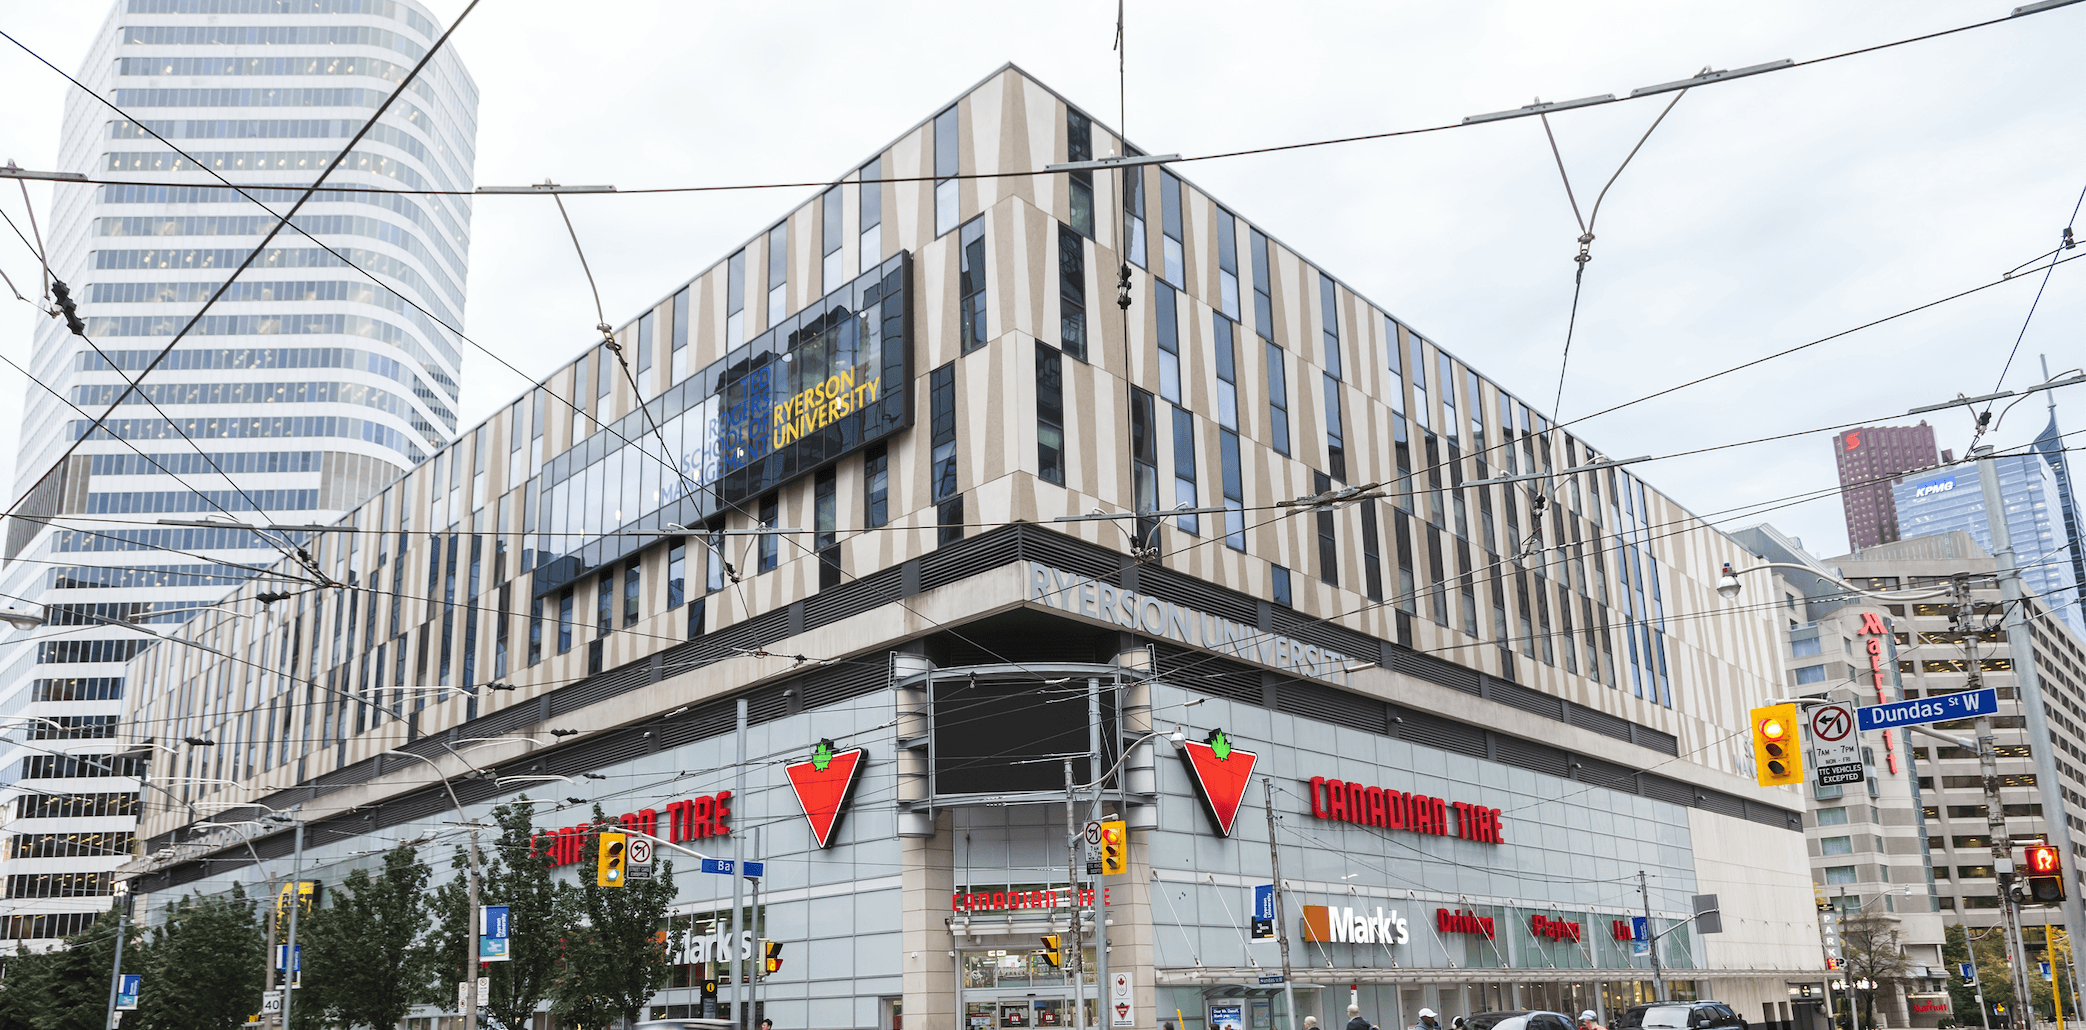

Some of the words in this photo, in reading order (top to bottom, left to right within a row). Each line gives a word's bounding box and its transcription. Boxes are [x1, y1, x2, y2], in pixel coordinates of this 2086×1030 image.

[740, 366, 771, 398] TED
[773, 365, 856, 428] RYERSON
[709, 388, 770, 439] ROGERS
[773, 376, 880, 449] UNIVERSITY
[682, 425, 746, 474] SCHOOL
[749, 411, 770, 439] OF
[661, 433, 770, 506] MANAGEMENT
[1916, 481, 1954, 498] KPMG
[1030, 560, 1193, 644] RYERSON
[1199, 610, 1356, 688] UNIVERSITY
[1871, 702, 1944, 724] Dundas
[1948, 697, 1959, 707] St
[1962, 693, 1980, 711] W
[1816, 748, 1830, 756] 7AM
[1840, 746, 1854, 754] 7PM
[1818, 768, 1830, 776] TTC
[1832, 764, 1862, 774] VEHICLES
[1824, 773, 1859, 784] EXCEPTED
[666, 790, 732, 844] TIRE
[1310, 775, 1448, 836] CANADIAN
[1452, 801, 1504, 844] TIRE
[952, 890, 1057, 911] CANADIAN
[1328, 906, 1409, 945] Mark's
[1436, 908, 1496, 941] Driving
[1532, 914, 1581, 944] Playing
[1823, 915, 1837, 957] PARK
[265, 1000, 279, 1010] 40
